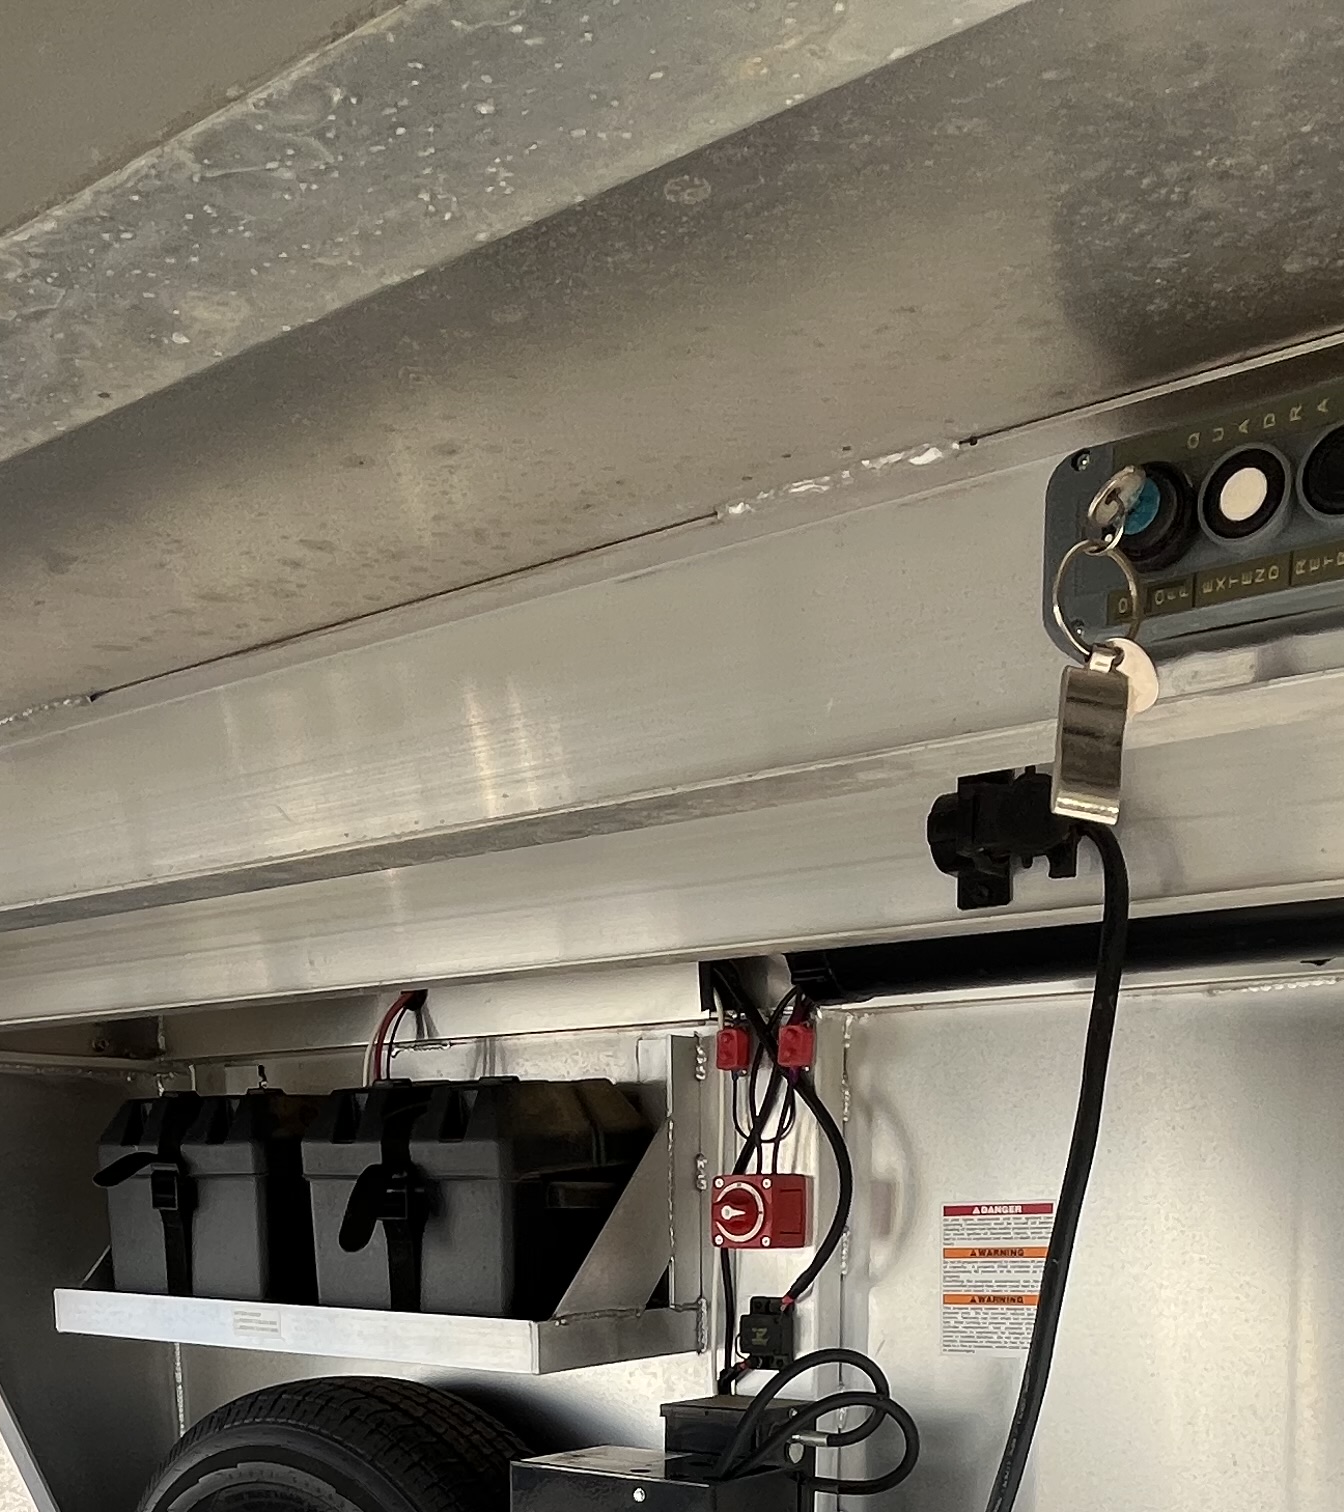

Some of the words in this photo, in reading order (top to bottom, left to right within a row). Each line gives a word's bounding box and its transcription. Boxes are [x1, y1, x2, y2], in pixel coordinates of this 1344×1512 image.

[1186, 397, 1329, 450] QUADRA
[1202, 564, 1280, 595] EXTEND
[981, 1205, 1023, 1215] DANGER
[978, 1249, 1025, 1257] WARNING
[978, 1296, 1024, 1304] WARNING
